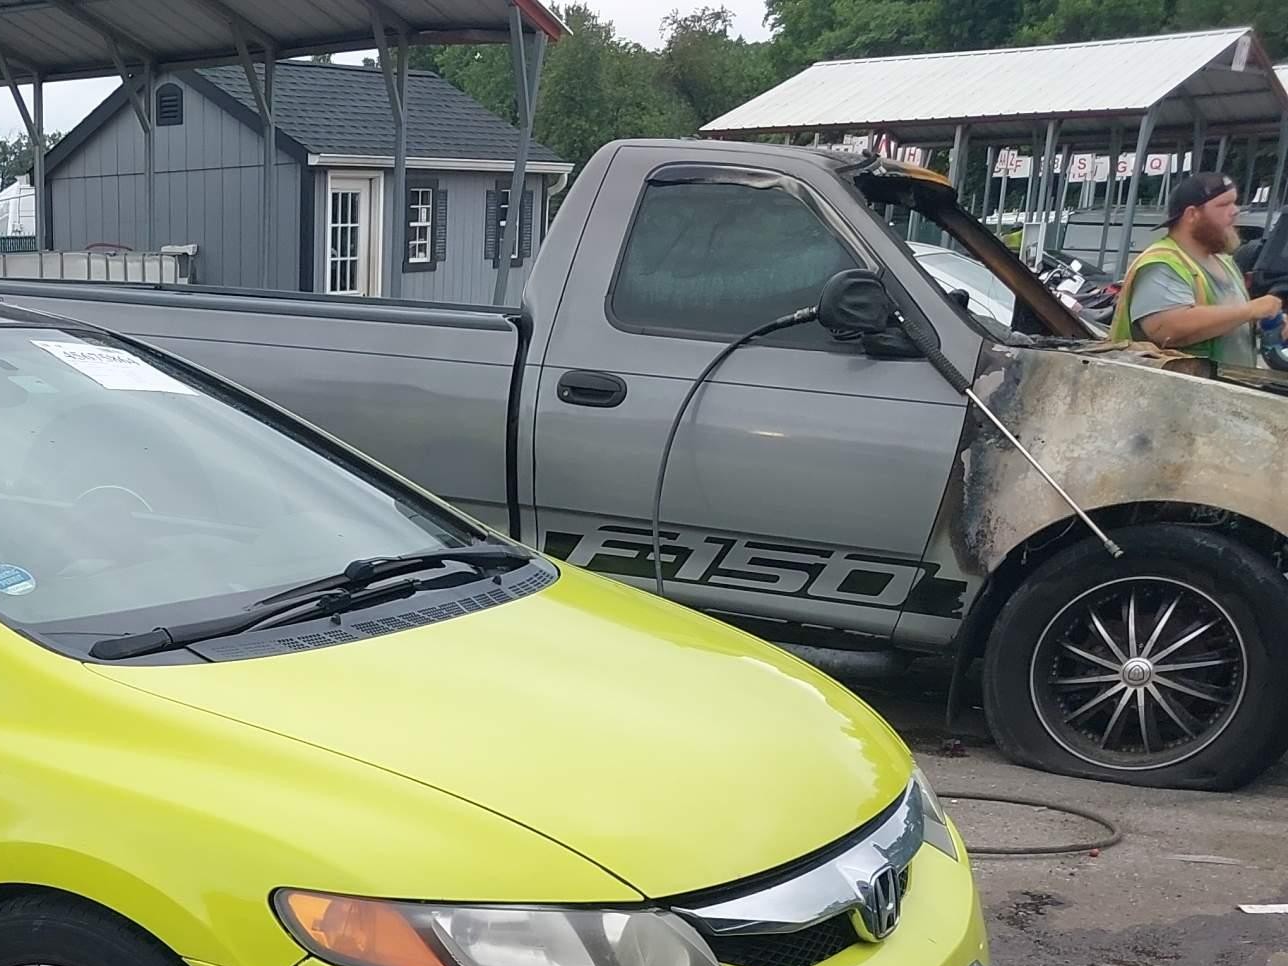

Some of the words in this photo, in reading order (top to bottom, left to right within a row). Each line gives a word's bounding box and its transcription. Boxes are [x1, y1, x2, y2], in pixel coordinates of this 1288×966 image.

[1078, 158, 1087, 170] S
[1117, 161, 1128, 173] G
[1150, 158, 1162, 170] Q
[565, 526, 926, 606] F-150
